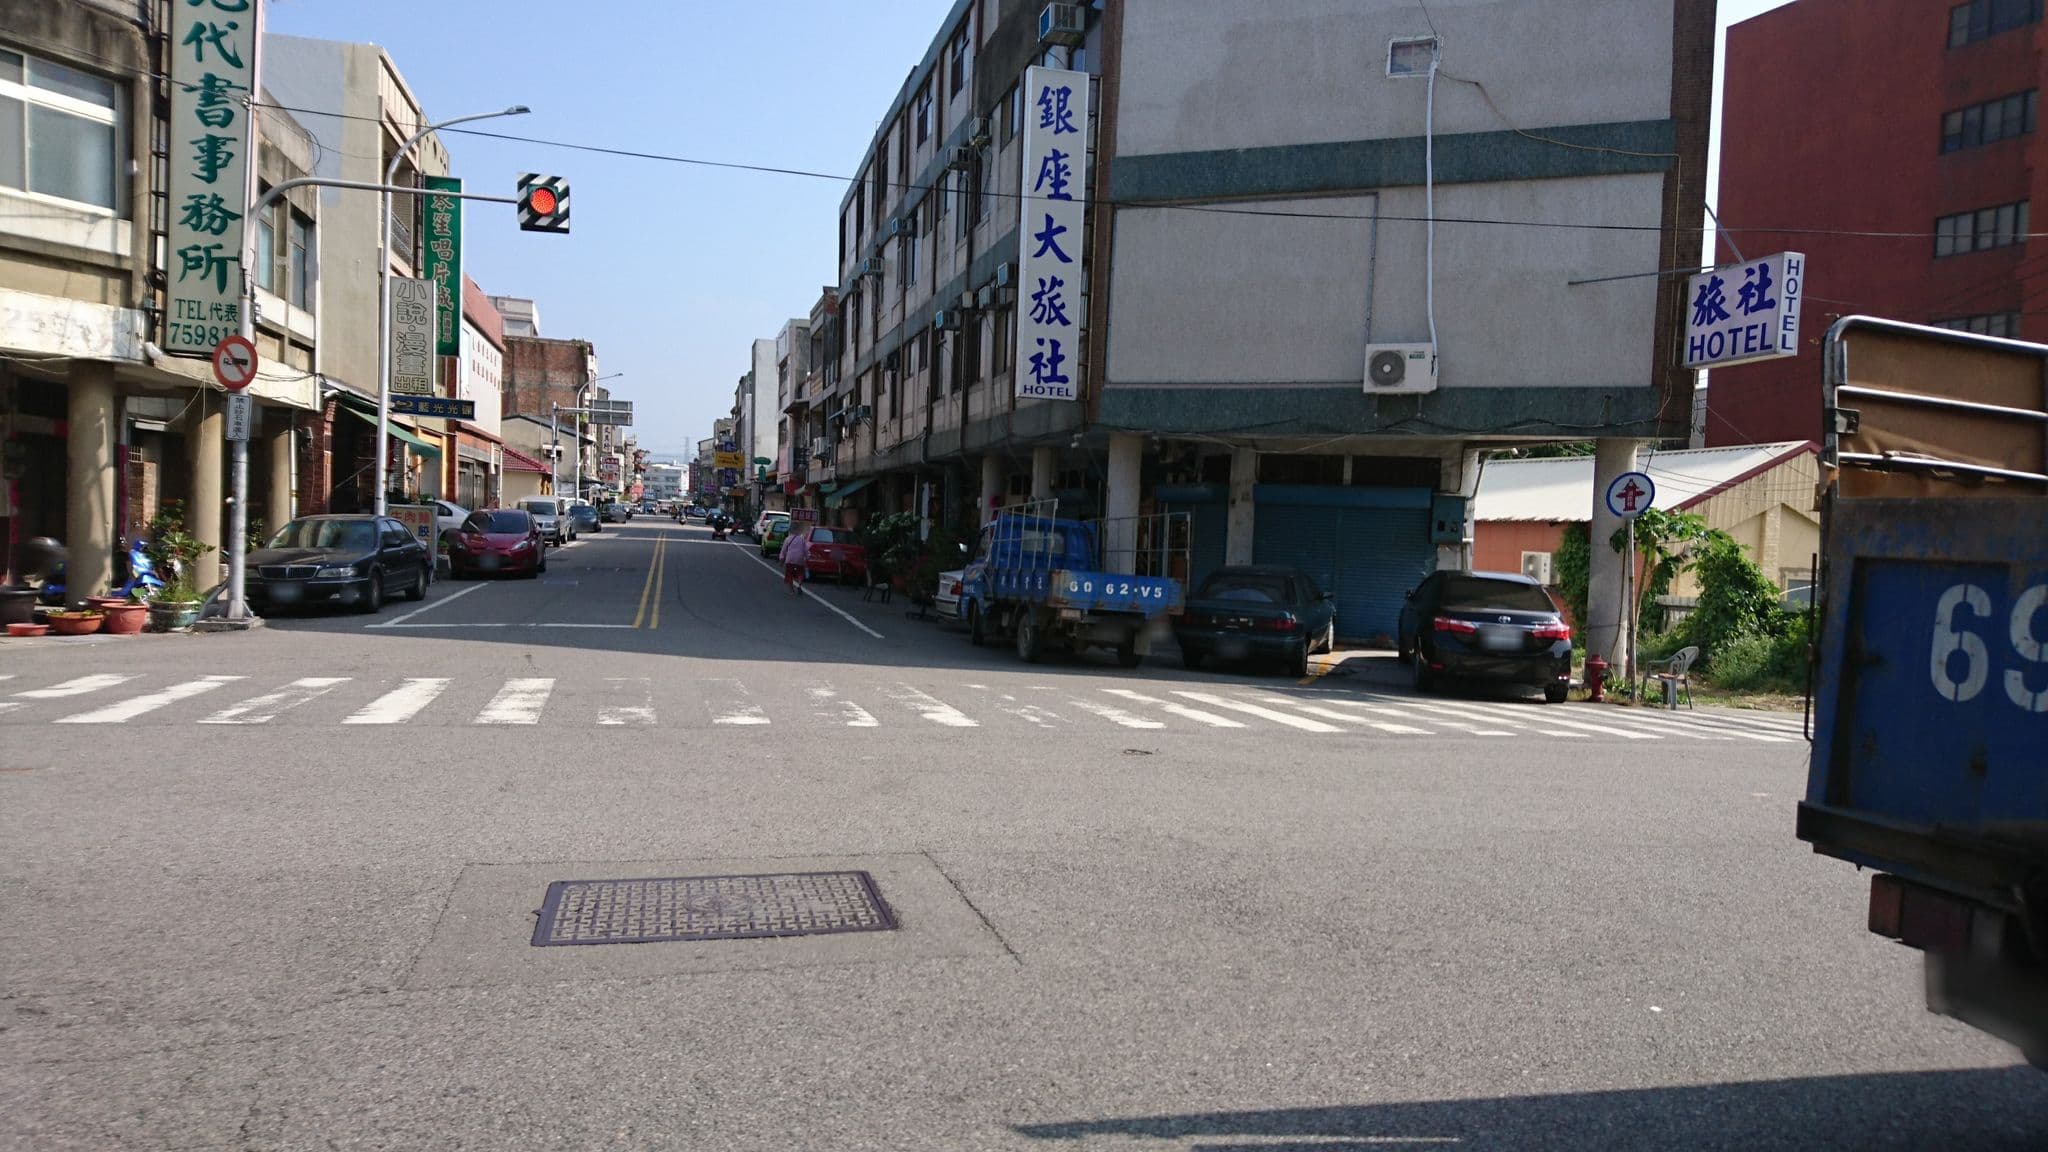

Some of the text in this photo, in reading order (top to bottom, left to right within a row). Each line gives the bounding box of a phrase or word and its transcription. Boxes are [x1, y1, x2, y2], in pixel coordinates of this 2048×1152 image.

[178, 0, 251, 295] 代書事務所
[1029, 85, 1078, 384] 銀座大旅社
[174, 298, 239, 322] TEL 代表
[1692, 262, 1776, 327] 旅社
[1780, 258, 1800, 350] HOTEL
[1689, 322, 1773, 362] HOTEL
[394, 377, 429, 393] 出租
[1023, 384, 1073, 397] HOTEL
